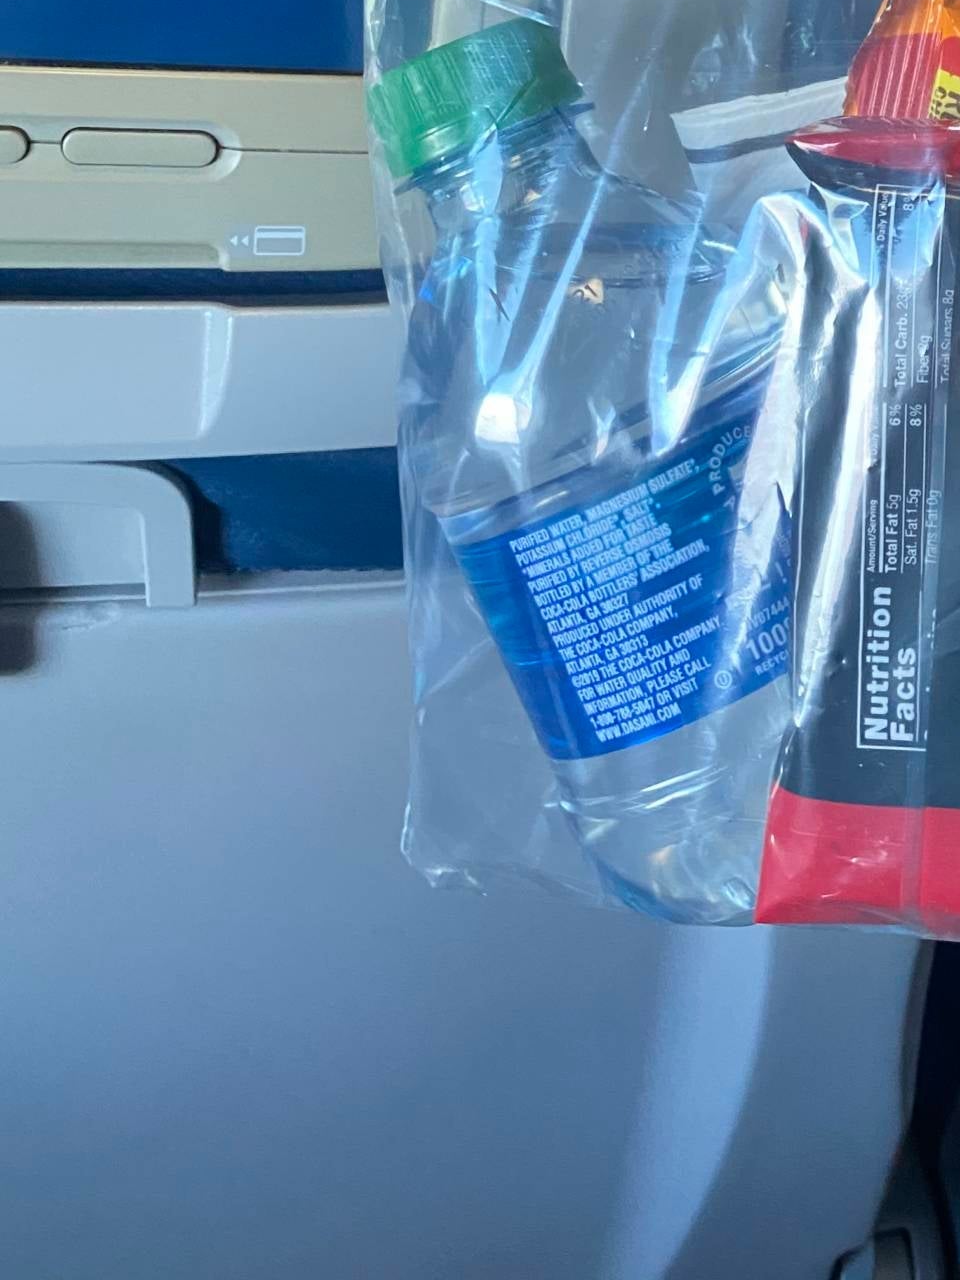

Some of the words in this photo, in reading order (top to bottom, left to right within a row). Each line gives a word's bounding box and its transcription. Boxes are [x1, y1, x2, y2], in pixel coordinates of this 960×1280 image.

[895, 312, 908, 349] Carb.
[893, 353, 906, 387] Total
[889, 403, 901, 426] 6%
[909, 404, 922, 426] 8%
[887, 494, 901, 509] 5g
[905, 488, 921, 512] 1.5g
[510, 529, 548, 551] PURIFIED
[586, 485, 648, 520] MAGNESIUM
[885, 513, 898, 534] Fat
[904, 518, 917, 537] Fat
[925, 508, 938, 528] Fat
[516, 538, 564, 565] POTASSIUM
[570, 539, 603, 560] ADDED
[603, 529, 624, 546] FOR
[624, 513, 656, 536] TASTE
[924, 534, 938, 563] Trans
[528, 571, 566, 592] PURIFIED
[567, 565, 579, 577] BY
[581, 545, 624, 572] REVERSE
[624, 523, 671, 554] OSMOSIS
[884, 538, 897, 572] Total
[904, 542, 917, 564] Sat.
[535, 584, 570, 605] BOTTLED
[572, 579, 584, 592] BY
[586, 576, 593, 586] A
[593, 557, 635, 583] MEMBER
[636, 550, 651, 565] OF
[652, 539, 672, 557] THE
[541, 594, 588, 619] COCA-COLA
[553, 622, 597, 646] PRODUCED
[599, 609, 631, 629] UNDER
[632, 582, 688, 615] AUTHORITY
[688, 574, 703, 589] OF
[586, 605, 599, 618] GA
[560, 647, 576, 660] THE
[576, 627, 625, 655] COCA-COLA
[599, 663, 617, 678] THE
[618, 640, 671, 670] COCA-COLA
[605, 646, 618, 659] GA
[578, 687, 595, 700] FOR
[596, 675, 625, 695] WATER
[626, 658, 667, 683] QUALITY
[668, 648, 689, 665] AND
[647, 668, 683, 690] PLEASE
[684, 656, 710, 674] CALL
[864, 586, 891, 739] Nutrition
[656, 690, 671, 704] OR
[672, 678, 698, 697] VISIT
[889, 647, 915, 741] Facts
